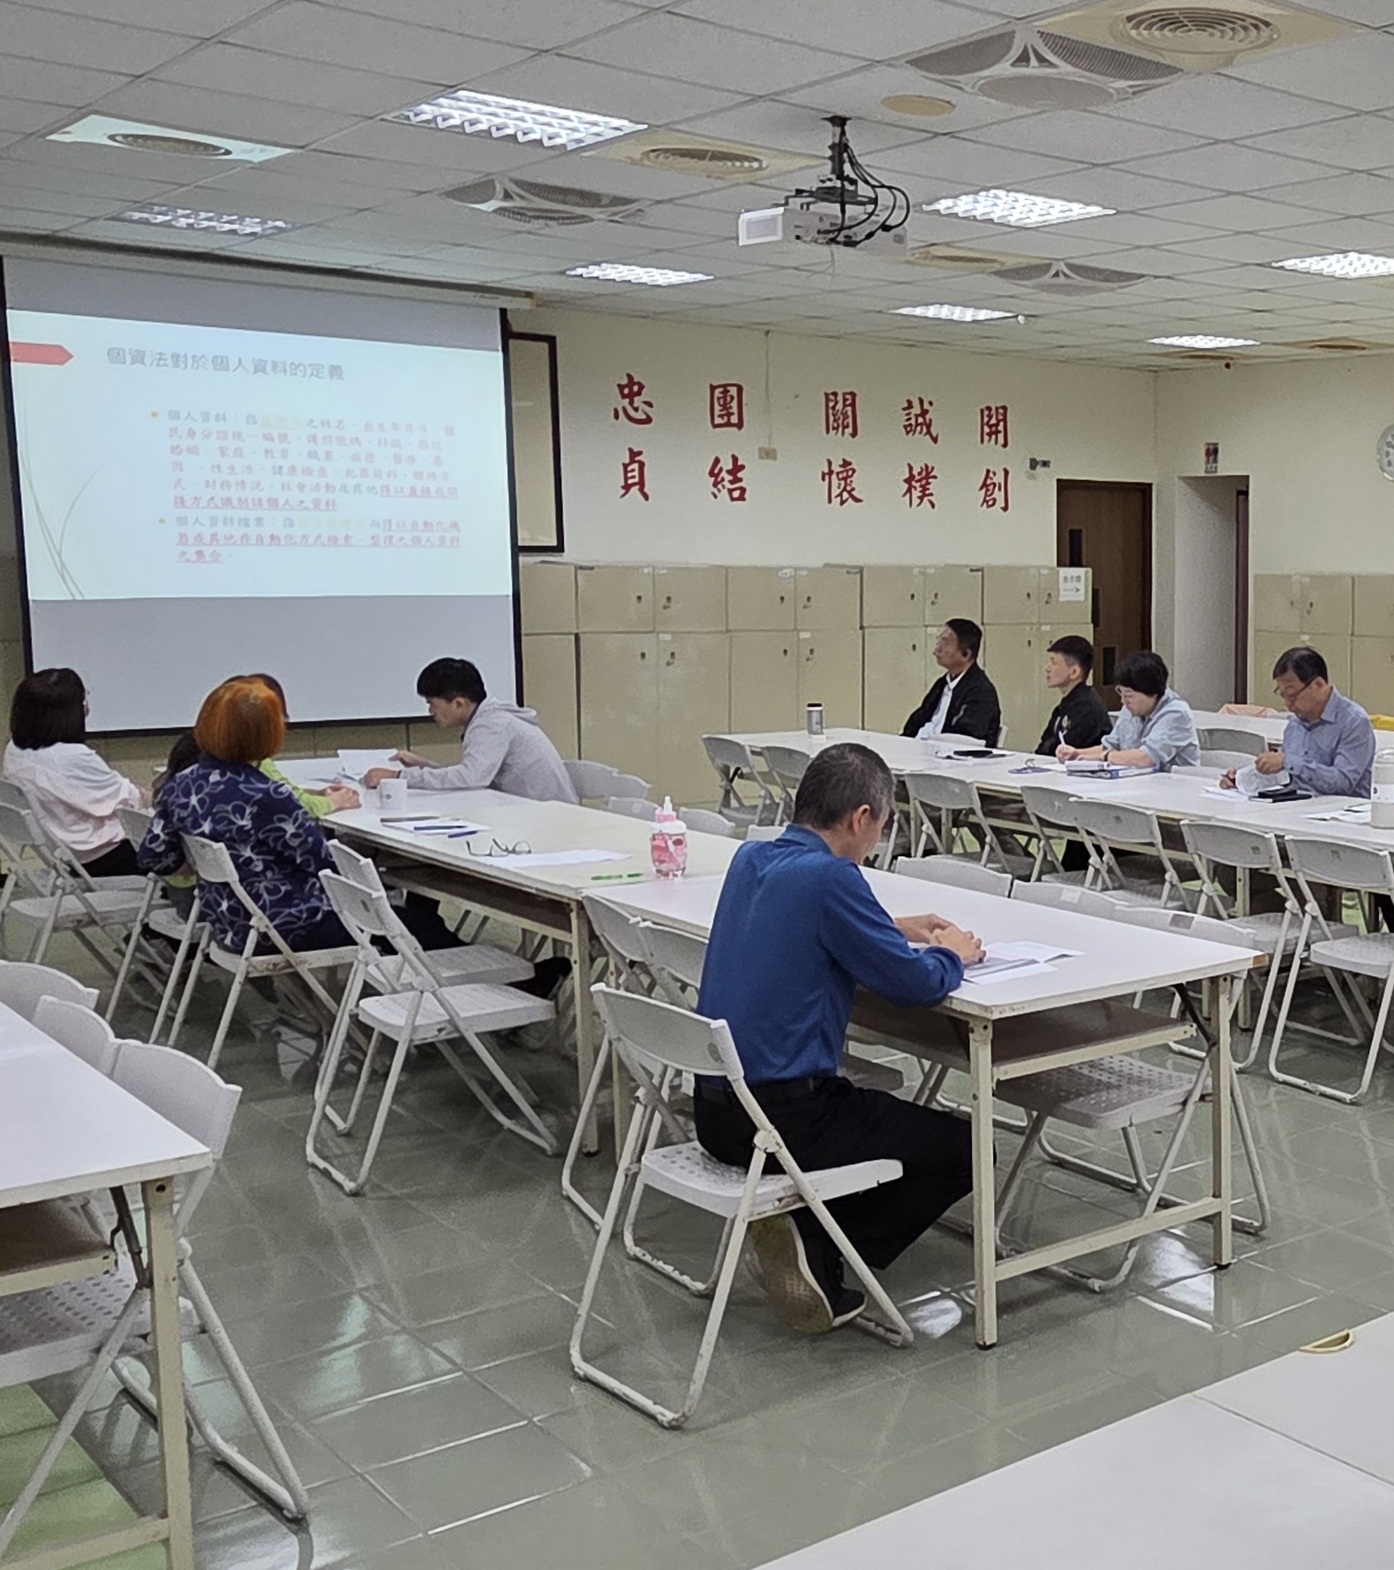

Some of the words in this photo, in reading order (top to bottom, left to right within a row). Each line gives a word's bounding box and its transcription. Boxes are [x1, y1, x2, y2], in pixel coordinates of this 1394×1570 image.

[107, 347, 345, 381] 個資法對於個人資料的定義
[613, 372, 654, 502] 忠貞
[708, 382, 746, 502] 團結
[821, 391, 864, 507] 關懷
[902, 396, 939, 509] 誠樸
[978, 405, 1010, 513] 開創
